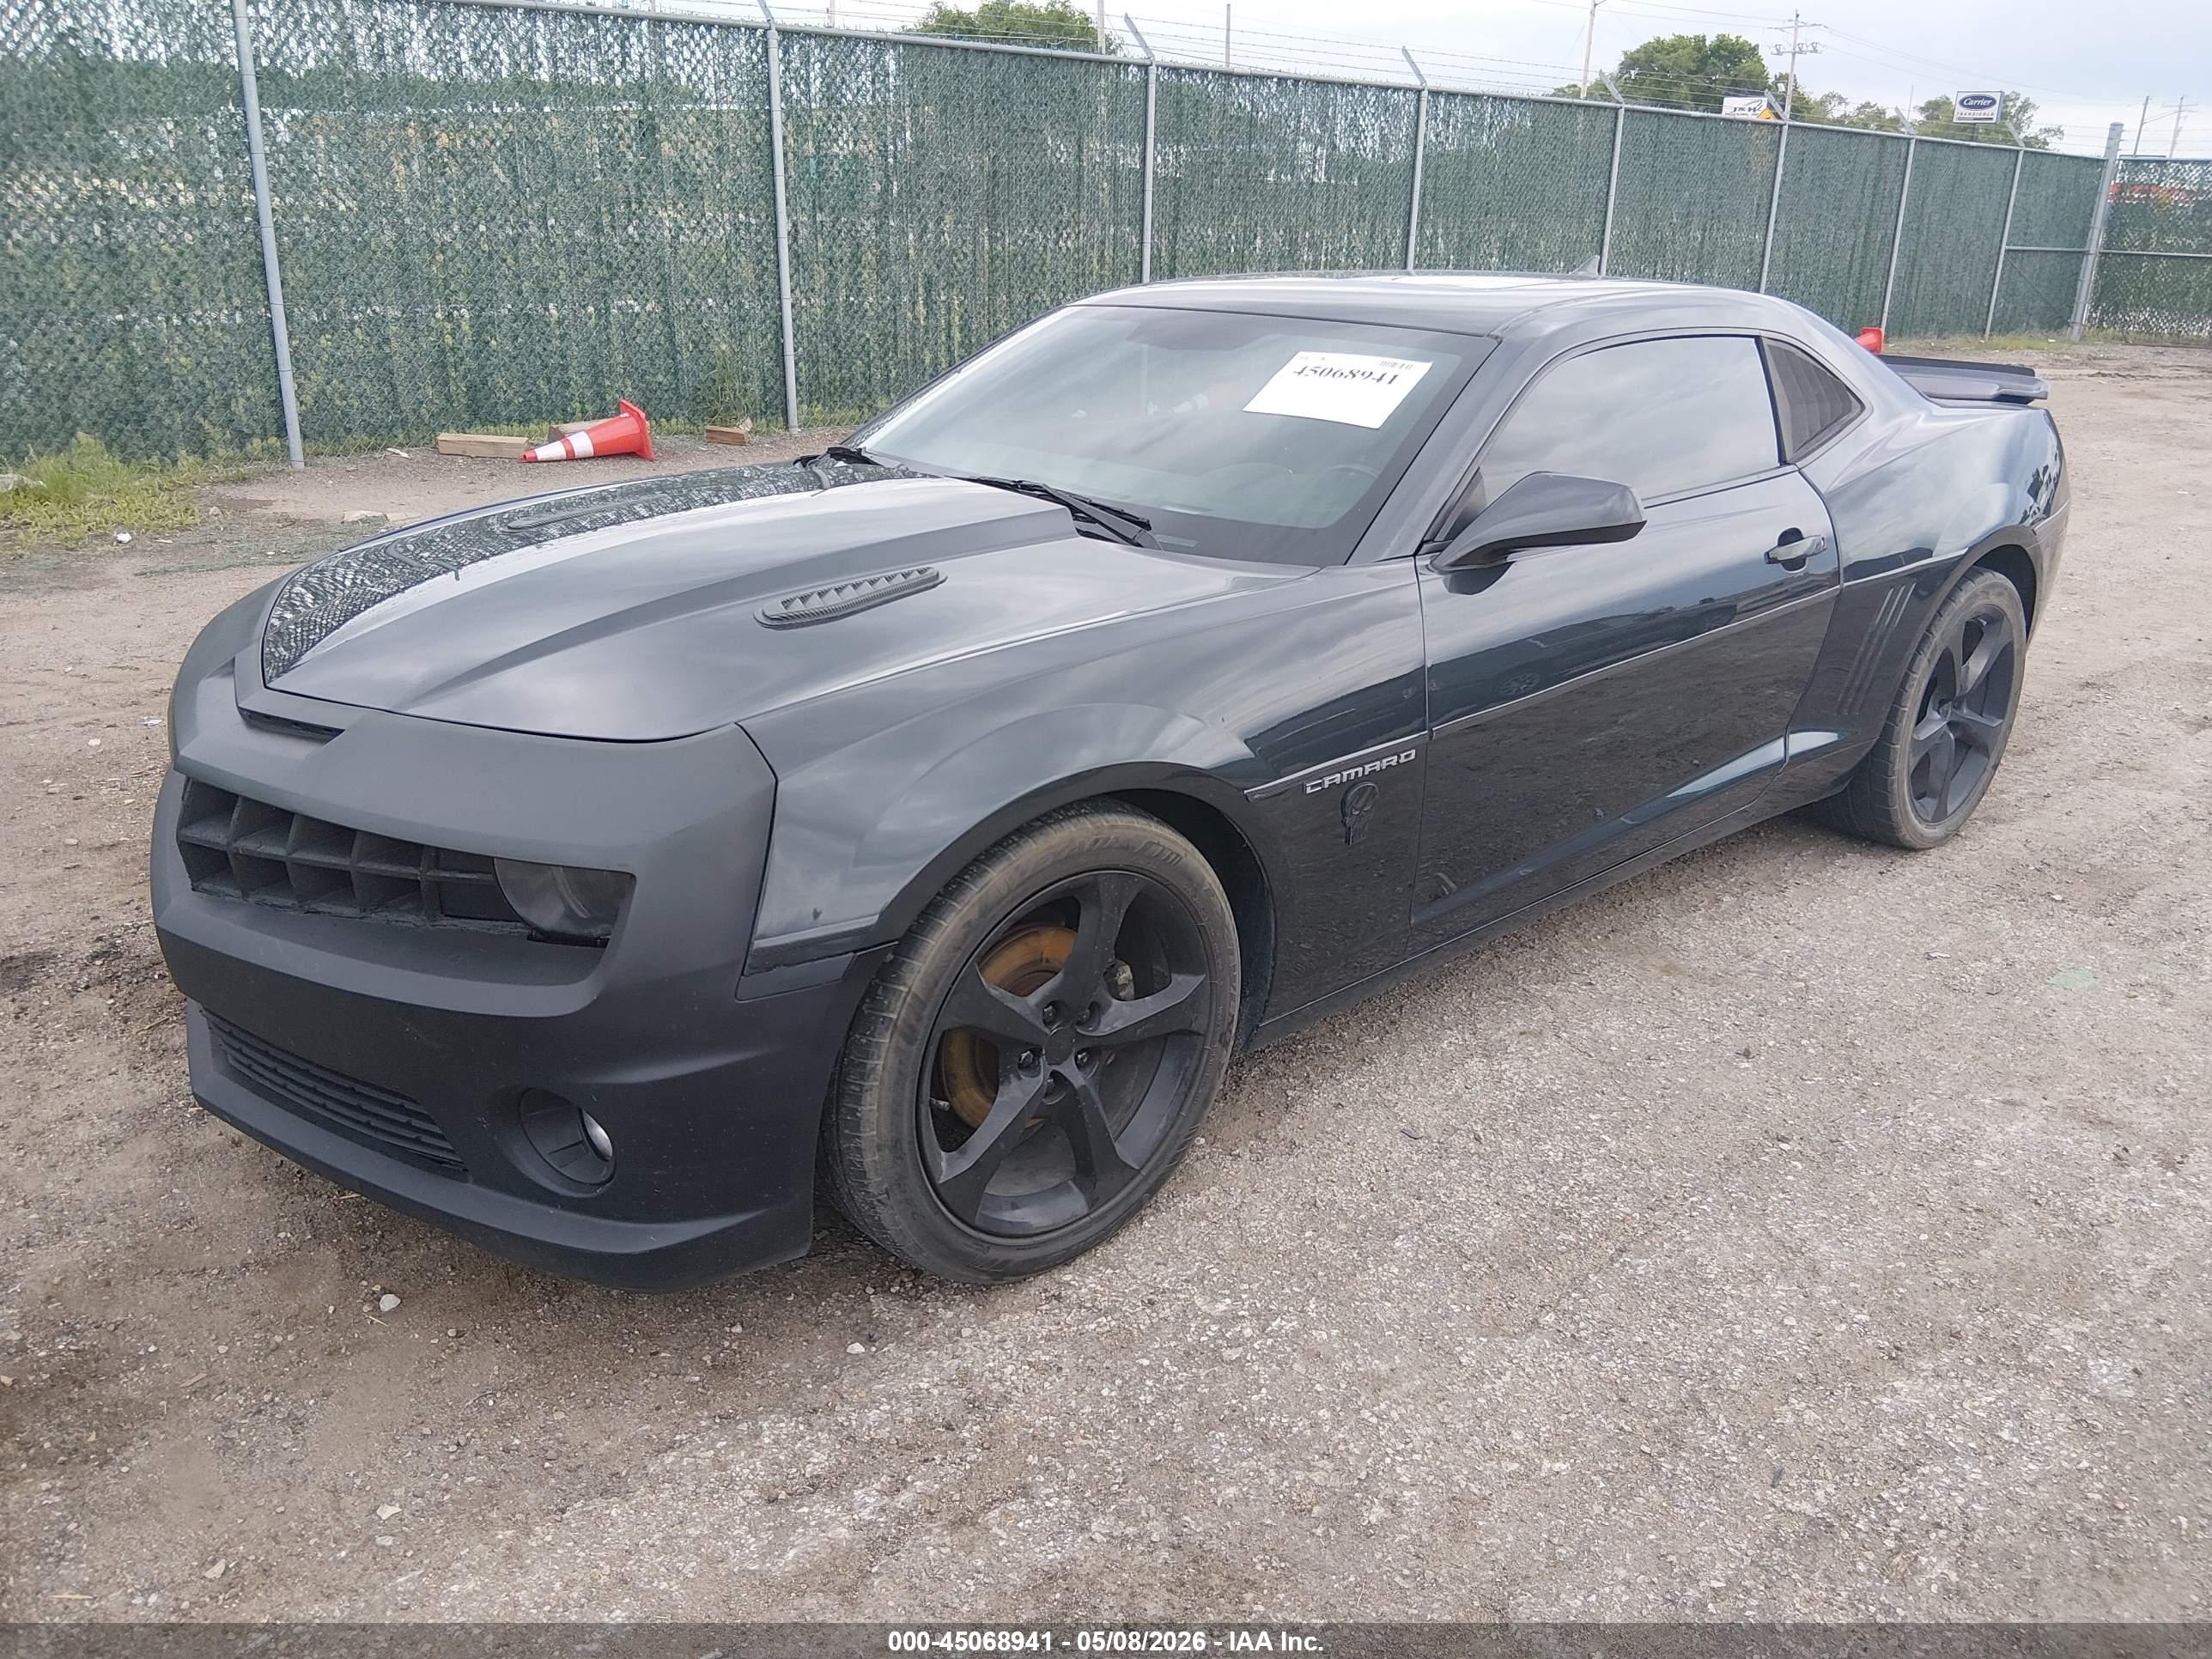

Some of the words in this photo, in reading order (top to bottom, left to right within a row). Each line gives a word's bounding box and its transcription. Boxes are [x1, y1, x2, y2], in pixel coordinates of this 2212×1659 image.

[1963, 97, 1993, 106] Carrier
[1292, 365, 1400, 386] 45068941
[1304, 749, 1416, 795] CAMARO
